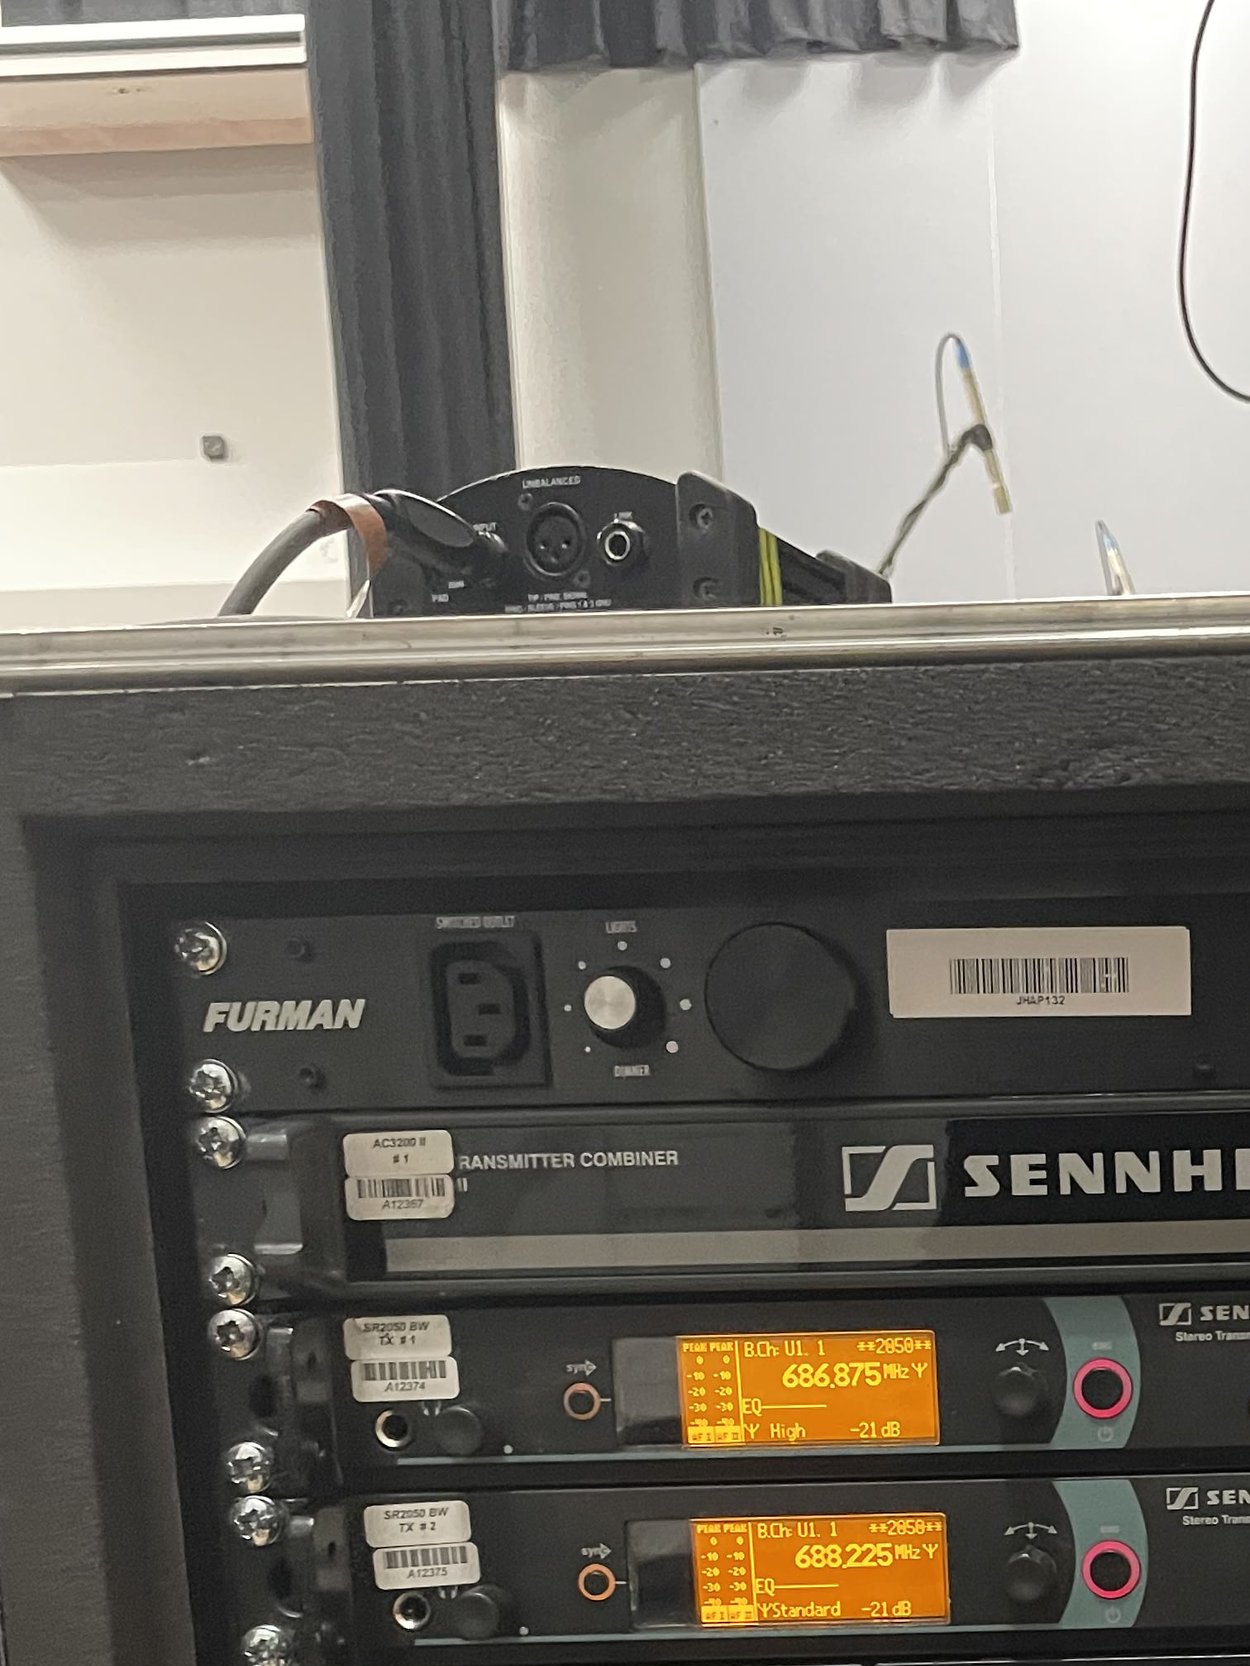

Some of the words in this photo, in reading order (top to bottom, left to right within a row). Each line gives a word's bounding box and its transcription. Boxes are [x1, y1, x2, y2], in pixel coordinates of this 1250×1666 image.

[522, 475, 581, 489] UNBALANCED
[1016, 995, 1066, 1006] JHAP132
[203, 999, 367, 1032] FURMAN
[373, 1137, 417, 1149] AC3200
[403, 1154, 409, 1163] 1
[458, 1152, 576, 1171] RANSMITTER
[579, 1150, 679, 1168] COMBINER
[363, 1321, 407, 1333] SR2050
[409, 1321, 430, 1332] BW
[411, 1335, 416, 1344] 1
[1175, 1330, 1213, 1342] Stereo
[817, 1340, 825, 1356] 1
[782, 1361, 882, 1389] 686.875
[883, 1362, 910, 1380] MHz
[743, 1398, 763, 1417] EQ
[770, 1423, 806, 1441] High
[850, 1423, 876, 1439] -21
[881, 1421, 901, 1438] dB
[384, 1508, 427, 1521] SR2050
[429, 1507, 449, 1519] BW
[1182, 1514, 1219, 1526] Stereo
[399, 1522, 415, 1533] TX
[430, 1521, 437, 1531] 2
[829, 1521, 838, 1537] 1
[794, 1542, 893, 1569] 688.225
[894, 1543, 921, 1560] MHz
[755, 1578, 775, 1596] EQ
[772, 1602, 841, 1618] Standard
[860, 1601, 888, 1618] -21
[892, 1600, 911, 1616] dB
